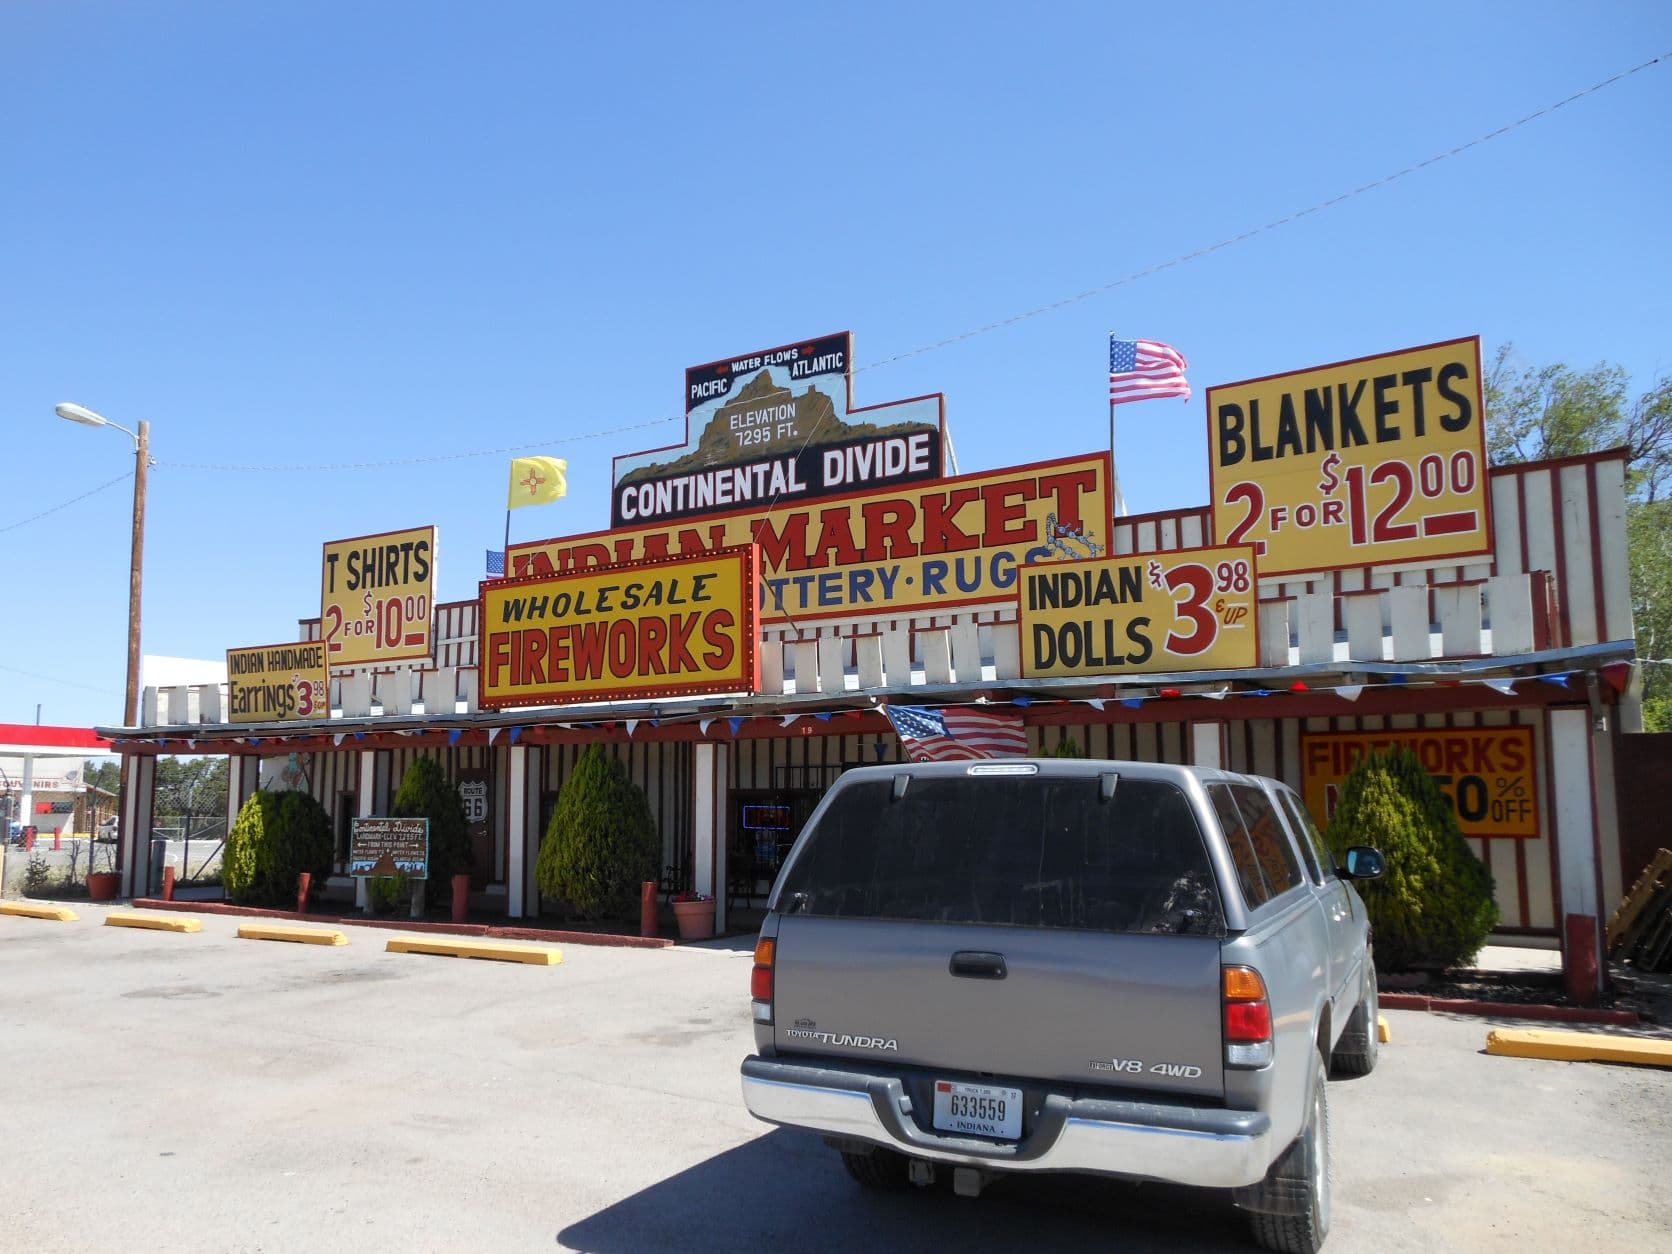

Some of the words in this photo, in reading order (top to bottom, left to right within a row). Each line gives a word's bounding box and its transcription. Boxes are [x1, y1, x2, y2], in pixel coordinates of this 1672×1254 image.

[731, 357, 761, 373] WATER
[764, 348, 799, 366] FLOWS
[792, 352, 843, 377] ATLANTIC
[690, 378, 728, 399] PACIFIC
[730, 403, 796, 430] ELEVATION
[1218, 362, 1472, 467] BLANKETS
[735, 427, 771, 447] 7295
[776, 419, 799, 440] FT.
[621, 458, 806, 520] CONTINENTAL
[823, 433, 930, 487] DIVIDE
[750, 469, 1097, 575] MARKET
[1224, 481, 1266, 556] 2
[1270, 500, 1344, 532] FOR
[326, 553, 339, 593] T
[347, 540, 429, 590] SHIRTS
[502, 573, 718, 623] WHOLESALE
[1028, 566, 1143, 611] INDIAN
[326, 604, 342, 651] 2
[344, 619, 374, 637] FOR
[1224, 606, 1248, 625] UP
[488, 608, 735, 688] FIREWORKS
[1033, 616, 1153, 670] DOLLS
[230, 652, 265, 675] INDIAN
[267, 647, 323, 672] HANDMADE
[231, 679, 295, 719] Earrings
[463, 787, 483, 795] ROUTE
[463, 798, 483, 817] 66
[1491, 798, 1532, 824] OFF
[785, 1029, 818, 1039] TOYOTA
[819, 1032, 898, 1051] TUNDRA
[1112, 1058, 1143, 1073] V8
[1150, 1063, 1202, 1078] 4WD
[951, 1094, 1006, 1122] 633559
[956, 1121, 996, 1133] INDIANA
